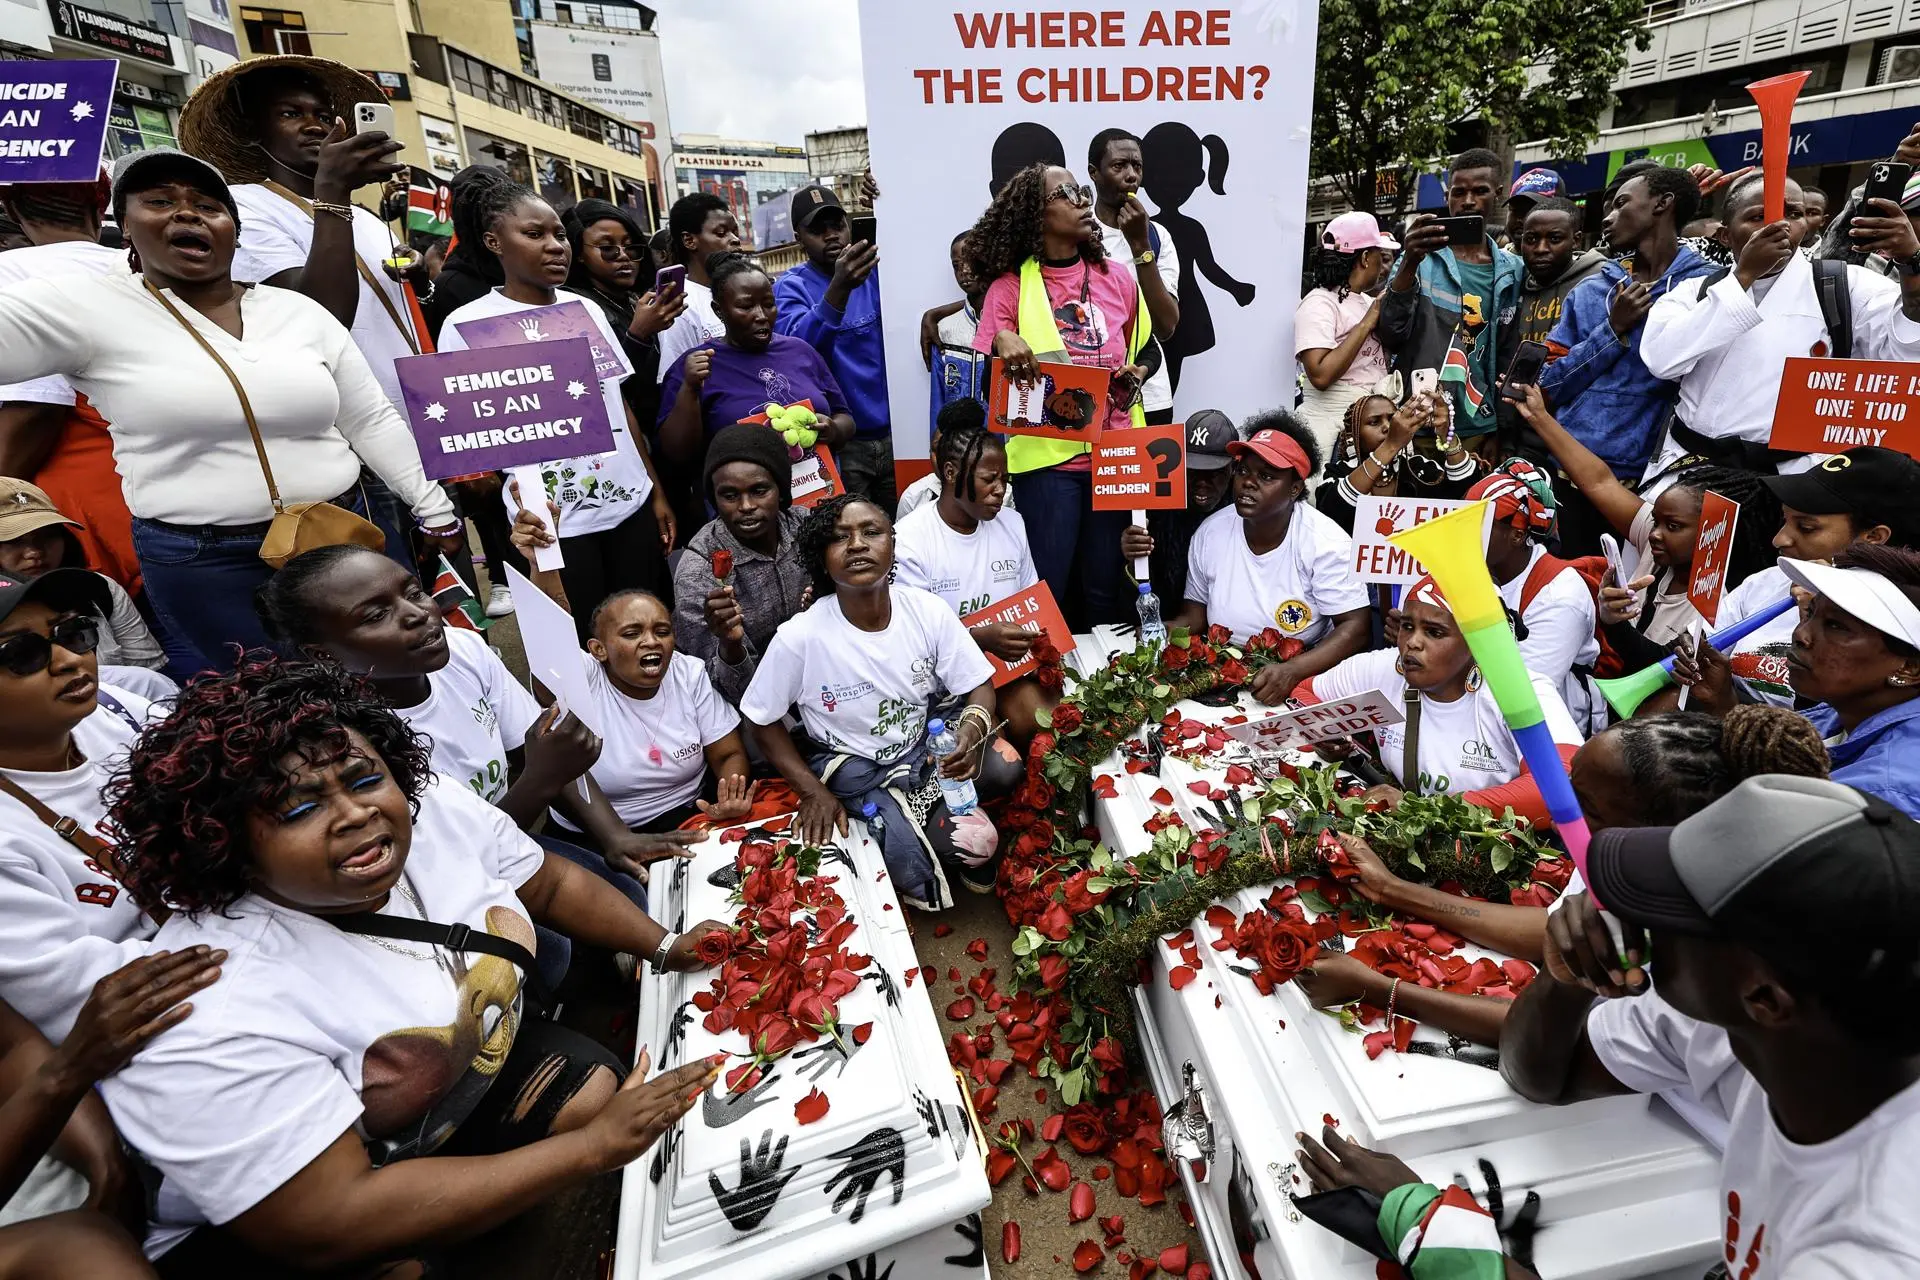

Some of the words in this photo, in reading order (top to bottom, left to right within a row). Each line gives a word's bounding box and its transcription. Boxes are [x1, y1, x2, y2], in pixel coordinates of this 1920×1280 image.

[953, 11, 1126, 49] WHERE
[1139, 9, 1231, 47] ARE
[914, 68, 1002, 104] THE
[1017, 65, 1271, 103] CHILDREN?
[680, 157, 730, 166] PLATINUM
[443, 364, 555, 394] FEMICIDE
[1807, 371, 1847, 391] ONE
[1854, 373, 1900, 394] LIFE
[472, 399, 496, 419] IS
[503, 393, 542, 416] AN
[1815, 398, 1855, 418] ONE
[1865, 401, 1907, 422] TOO
[439, 416, 584, 454] EMERGENCY
[1823, 424, 1888, 447] MANY
[1100, 446, 1137, 458] WHERE
[1097, 467, 1117, 476] ARE
[1121, 464, 1141, 475] THE
[1094, 483, 1150, 495] CHILDREN
[959, 593, 991, 616] END
[1024, 596, 1040, 613] IS
[835, 683, 875, 699] Hospital
[1292, 703, 1358, 727] END
